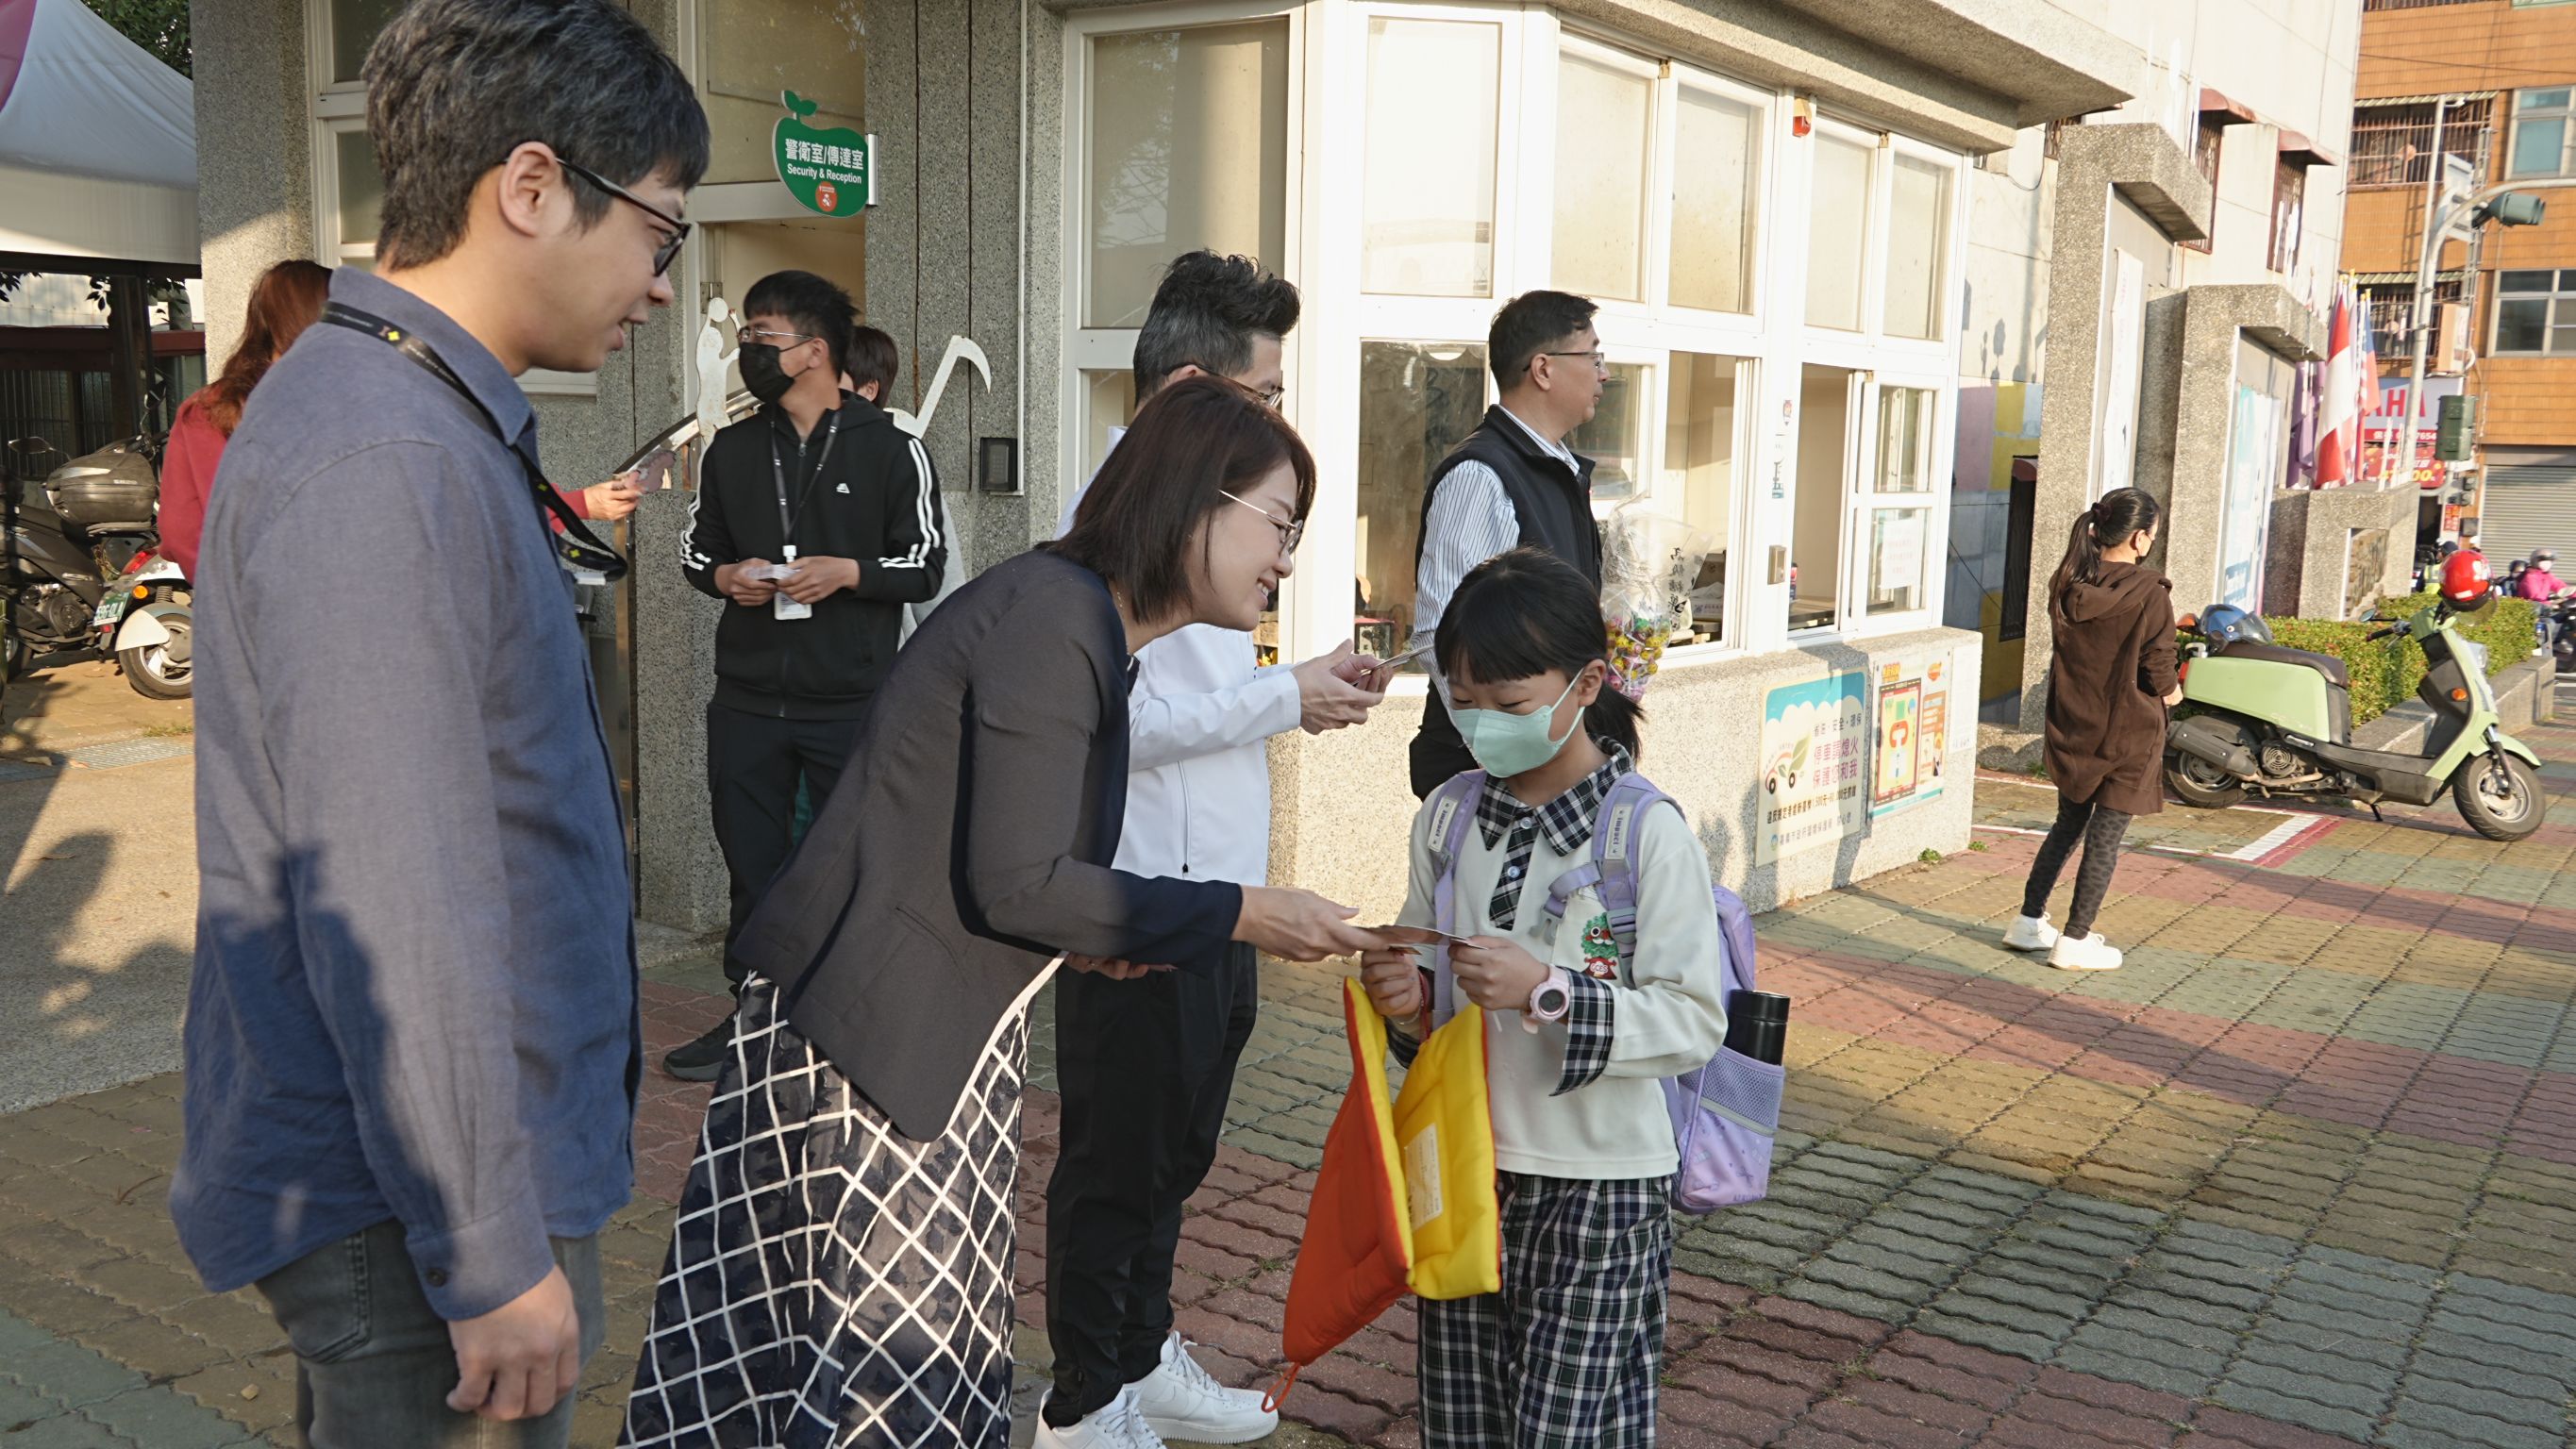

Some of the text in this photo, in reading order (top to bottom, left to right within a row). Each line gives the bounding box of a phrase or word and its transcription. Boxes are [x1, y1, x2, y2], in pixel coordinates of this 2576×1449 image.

[785, 139, 864, 170] 警衛室/傳達室
[787, 163, 862, 184] Security & Reception
